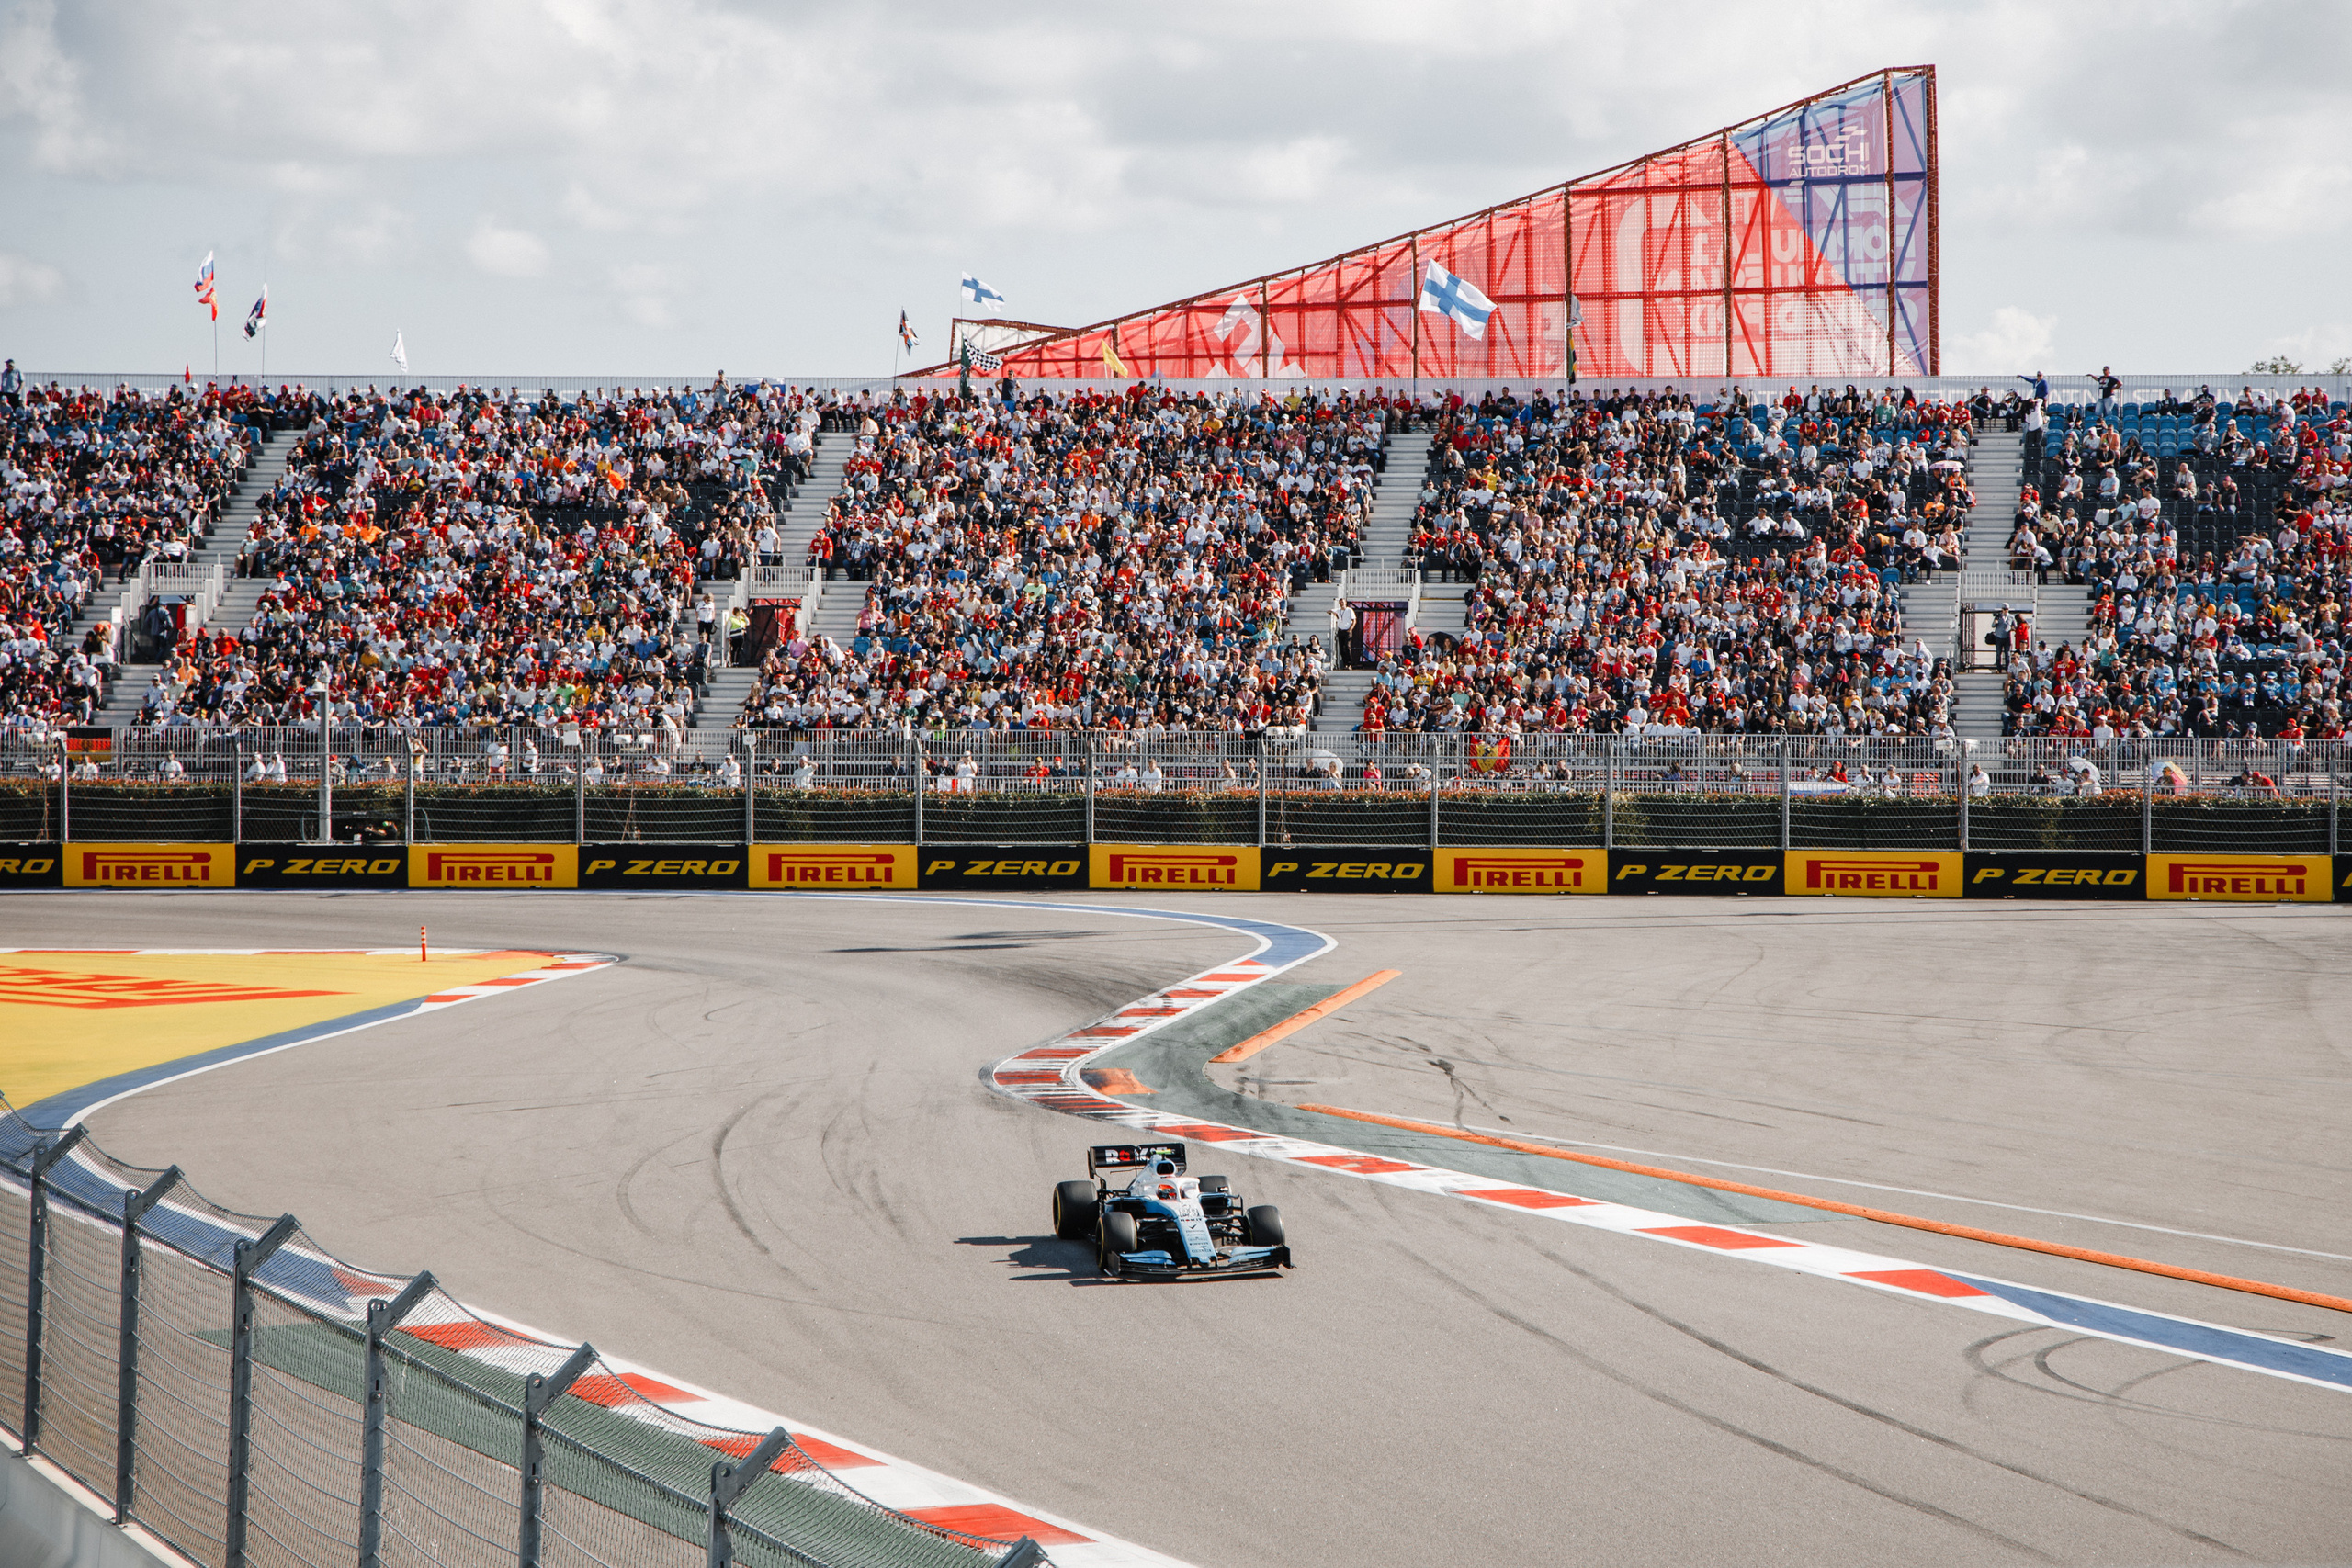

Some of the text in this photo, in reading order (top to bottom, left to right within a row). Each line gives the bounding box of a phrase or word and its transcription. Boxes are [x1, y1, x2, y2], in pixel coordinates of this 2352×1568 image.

[1788, 142, 1870, 165] SOCHI
[1788, 164, 1871, 178] AUTODROM
[82, 852, 212, 882] PIRELLI
[243, 859, 401, 874] P ZERO
[427, 852, 555, 882] PIRELLI
[585, 860, 741, 875] P ZERO
[767, 853, 895, 883] PIRELLI
[925, 860, 1081, 876] P ZERO
[1109, 853, 1238, 885] PIRELLI
[1268, 862, 1425, 879] P ZERO
[1453, 857, 1585, 887] PIRELLI
[1615, 864, 1777, 881] P ZERO
[1805, 859, 1940, 891] PIRELLI
[1972, 868, 2138, 885] P ZERO
[2168, 863, 2308, 896] PIRELLI
